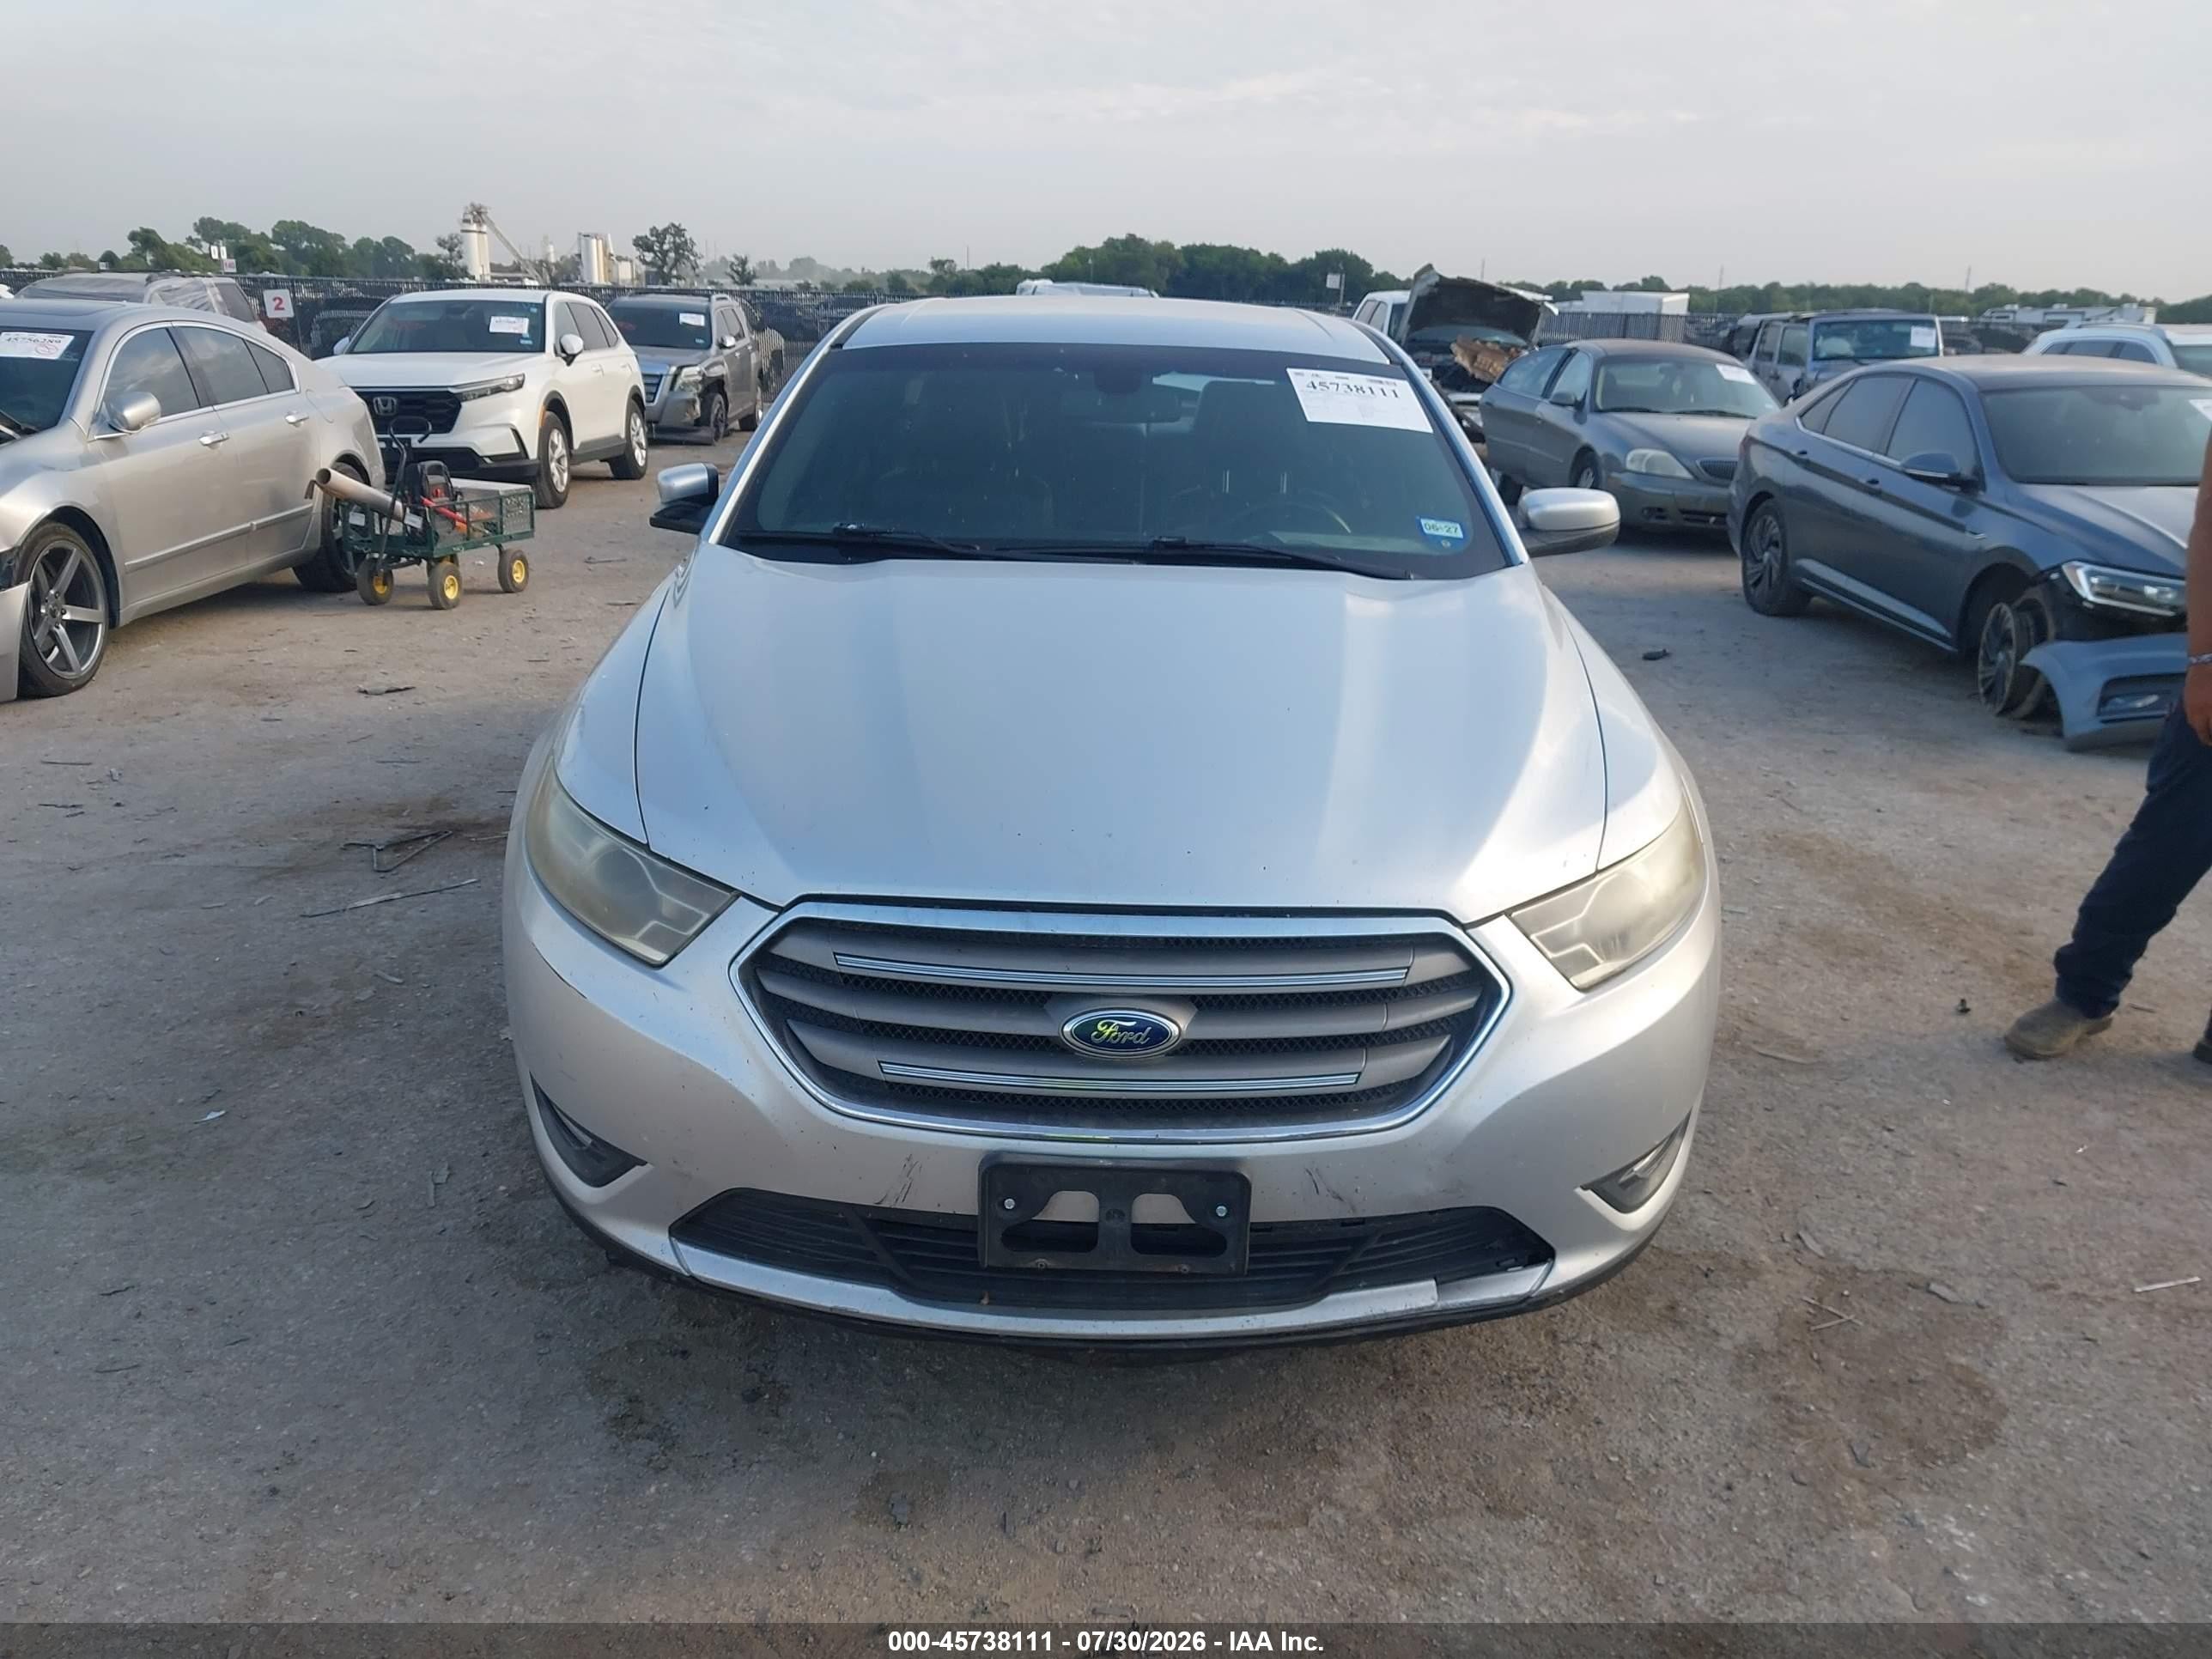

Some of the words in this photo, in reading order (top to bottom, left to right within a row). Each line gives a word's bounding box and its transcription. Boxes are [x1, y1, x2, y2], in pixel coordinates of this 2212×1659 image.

[272, 296, 285, 311] 2
[1305, 380, 1401, 398] 45738111
[1091, 1019, 1152, 1045] Ford
